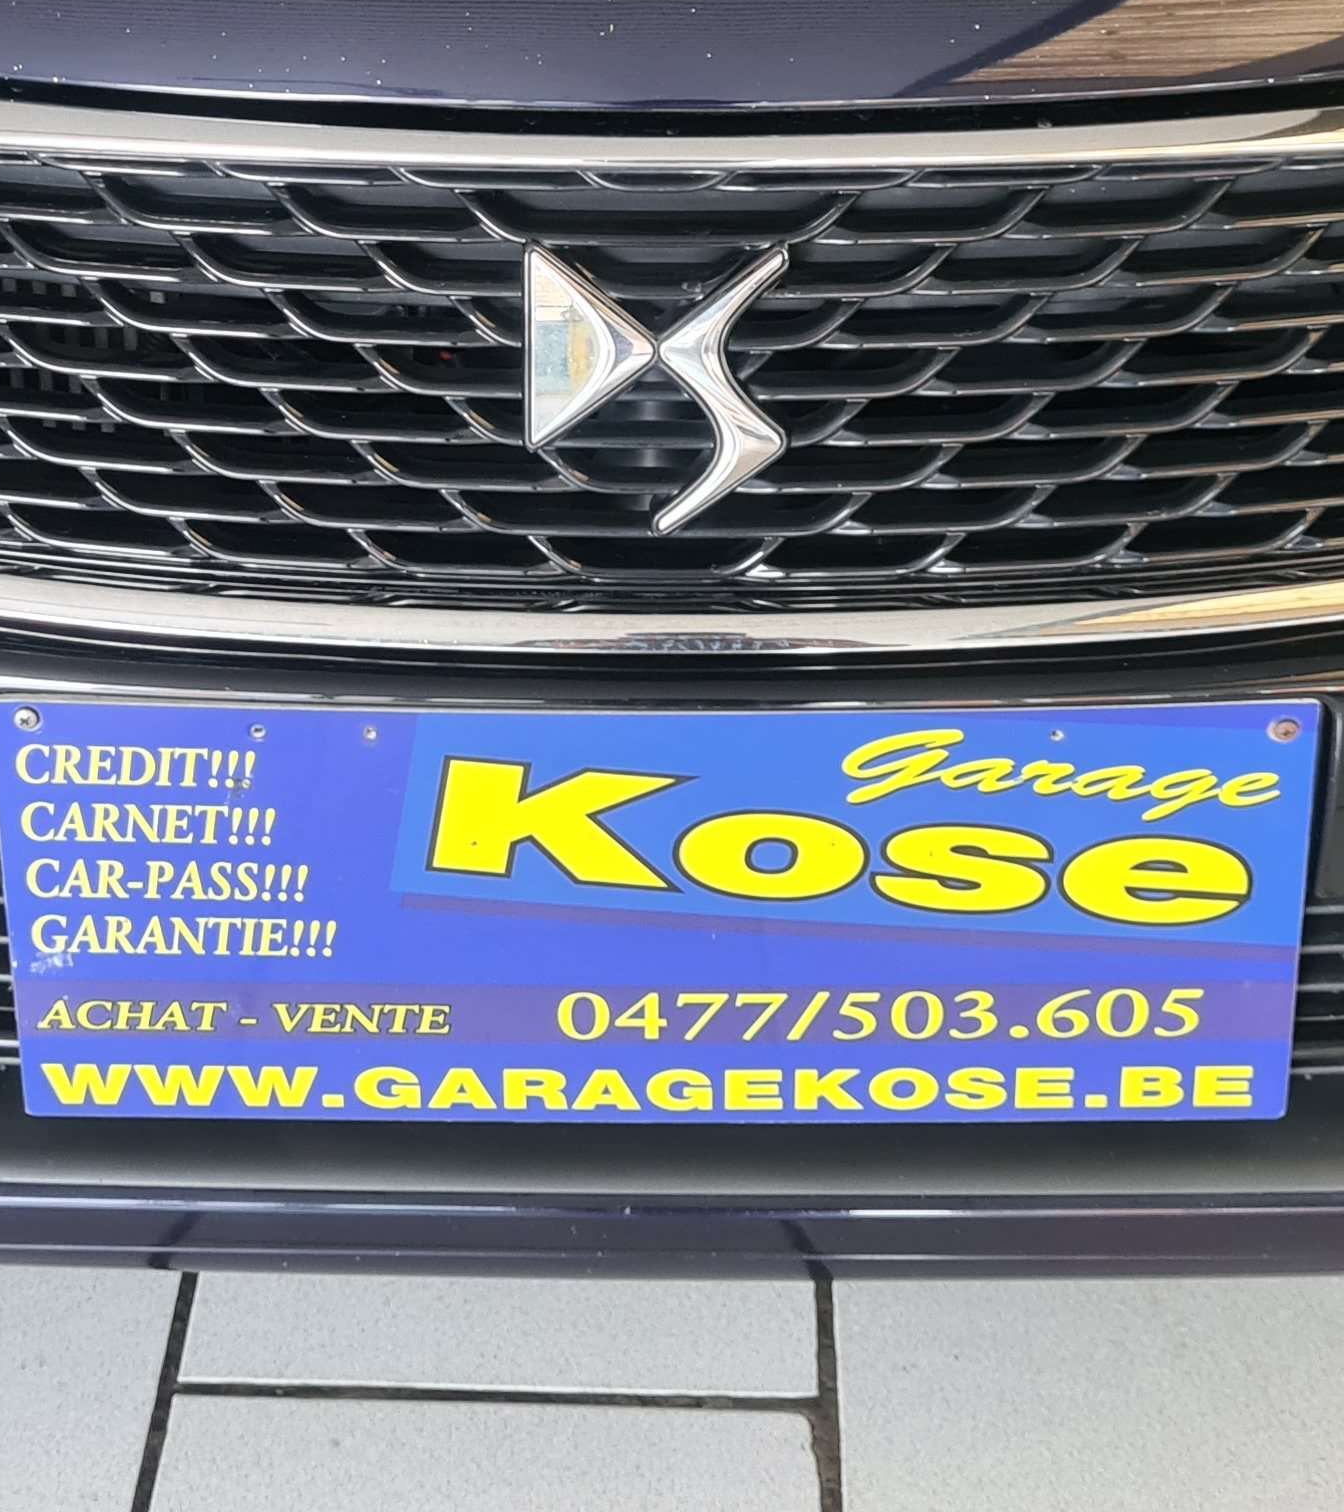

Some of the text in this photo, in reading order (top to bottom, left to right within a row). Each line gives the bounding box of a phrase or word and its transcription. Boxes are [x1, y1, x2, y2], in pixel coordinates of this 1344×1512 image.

[14, 743, 257, 790] CREDIT!!!
[840, 728, 1282, 822] Garage
[20, 801, 277, 847] CARNET!!!
[426, 754, 1254, 927] Kose
[25, 858, 310, 903] CAR-PASS!!!
[30, 914, 338, 959] GARANTIE!!!
[36, 997, 229, 1033] ACHAT
[272, 1001, 452, 1035] VENTE
[556, 986, 1205, 1043] 0477/503.605
[41, 1062, 1255, 1112] WWW.GARAGEKOSE.BE
